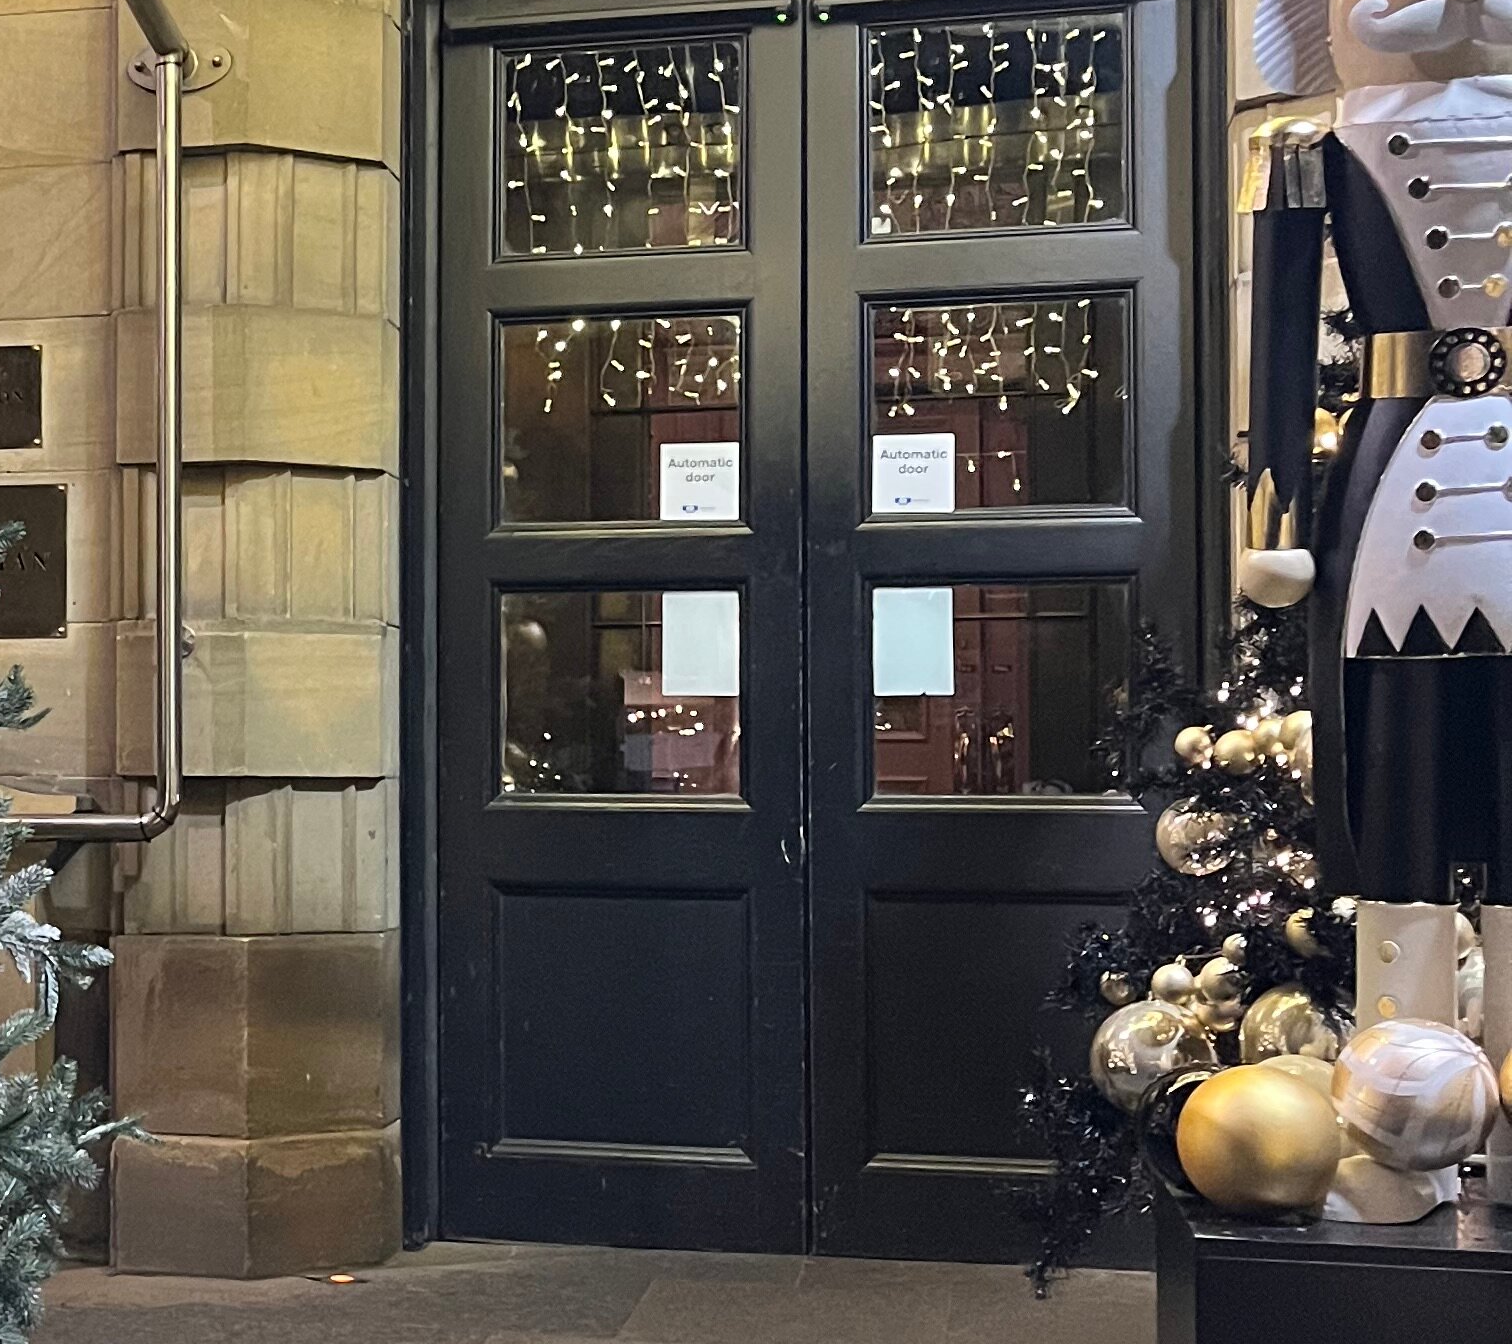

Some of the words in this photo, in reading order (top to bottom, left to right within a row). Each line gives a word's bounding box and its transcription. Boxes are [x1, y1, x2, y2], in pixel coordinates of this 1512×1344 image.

[880, 449, 948, 461] Automatic
[668, 457, 734, 469] Automatic
[898, 464, 928, 474] door
[685, 472, 716, 483] door
